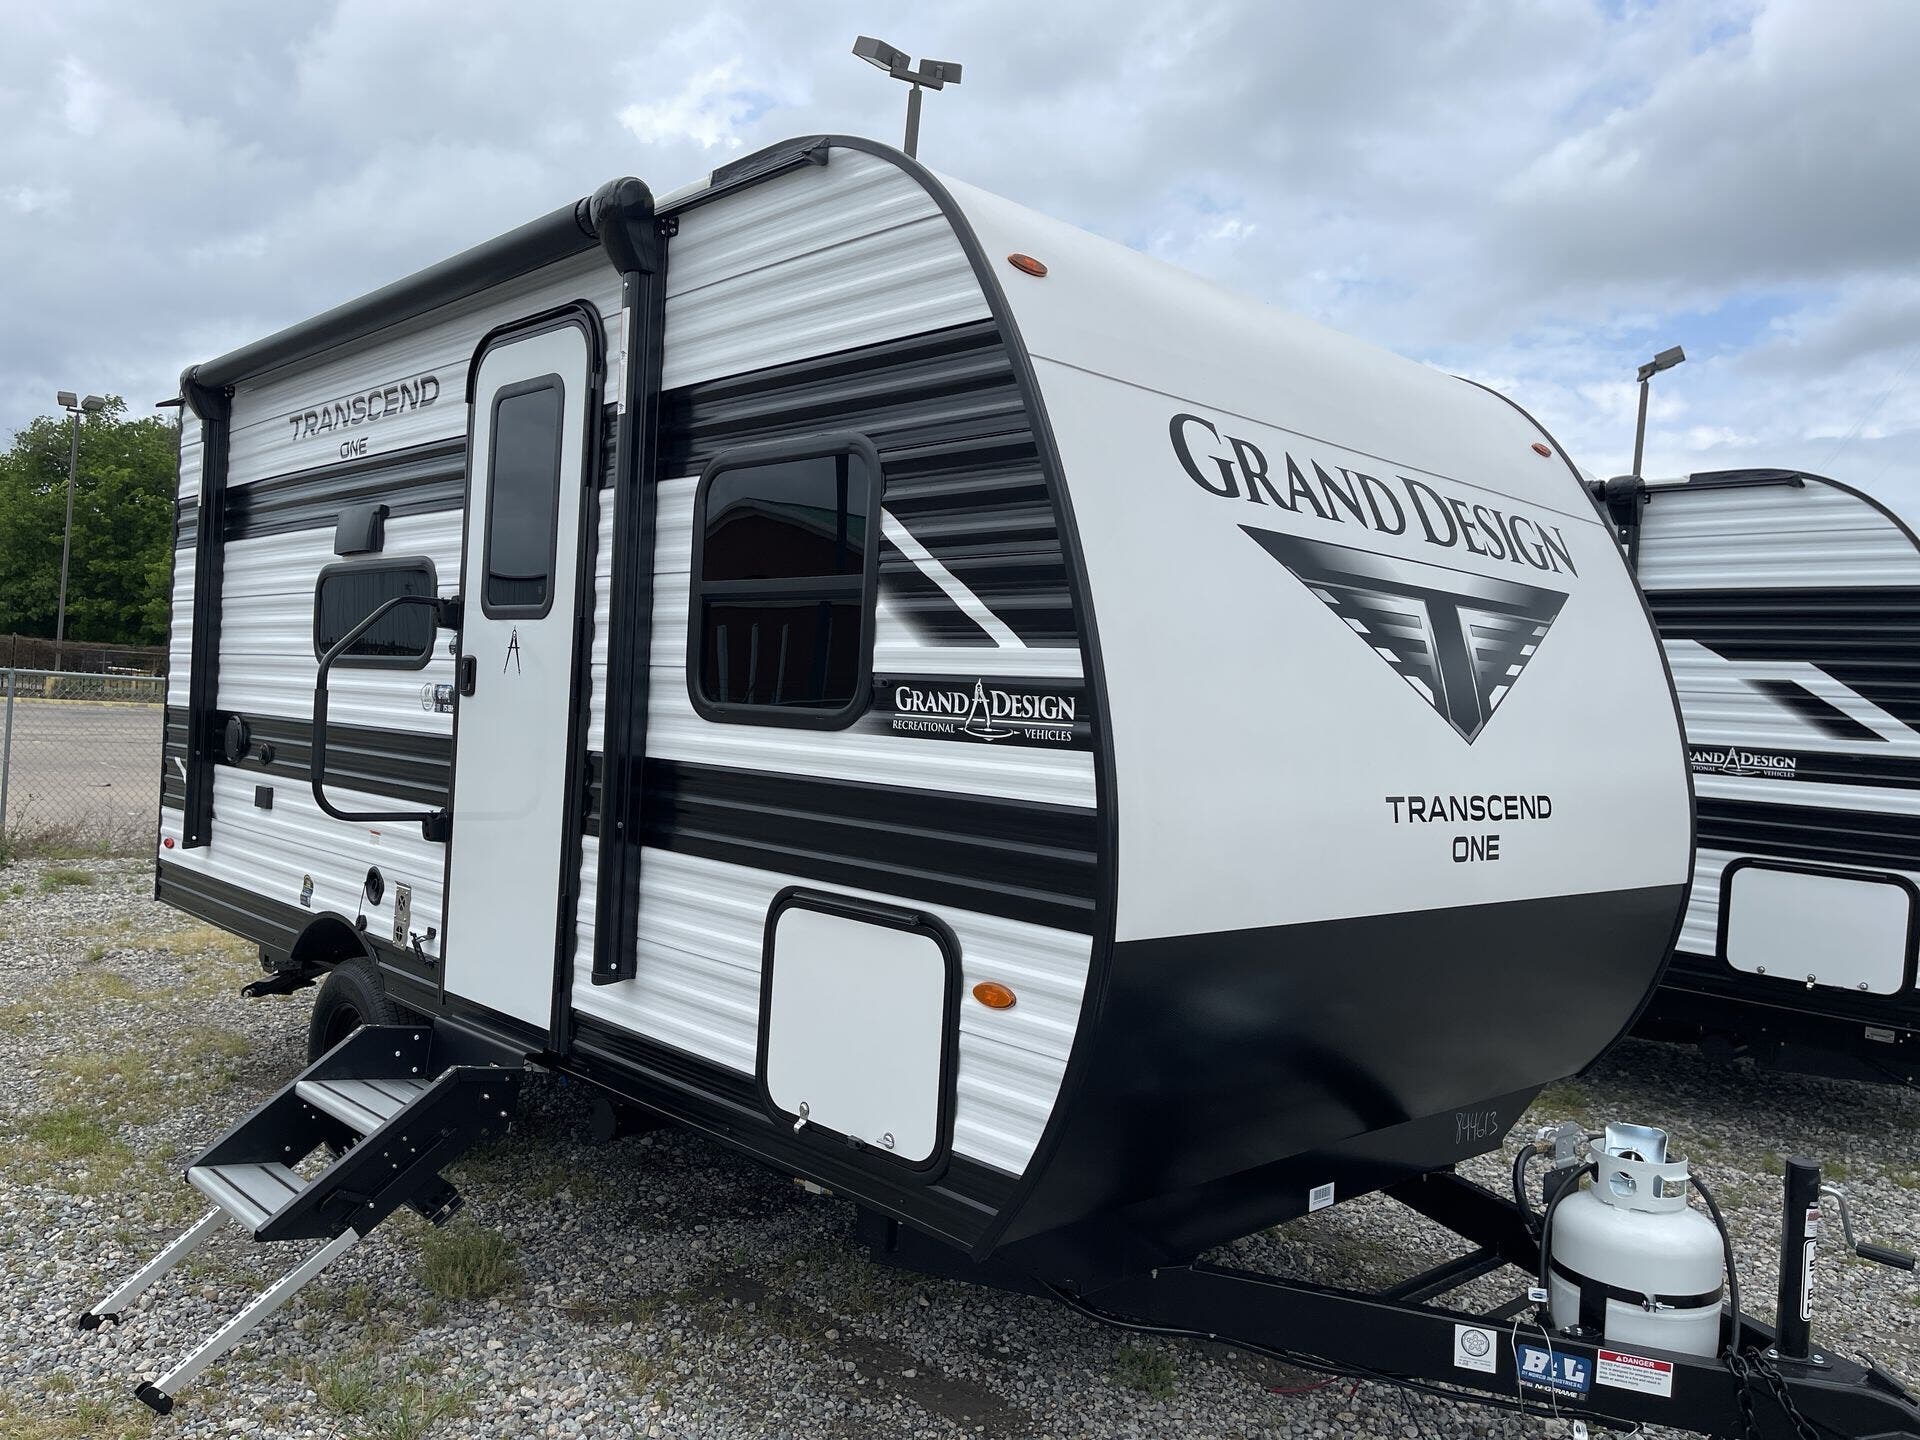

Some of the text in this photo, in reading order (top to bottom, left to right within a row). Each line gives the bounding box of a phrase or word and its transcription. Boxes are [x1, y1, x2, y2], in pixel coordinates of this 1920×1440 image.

[289, 375, 440, 441] TRANSCEND
[339, 437, 369, 459] ONE
[1168, 413, 1579, 579] GRAND DESIGN
[895, 686, 1076, 721] GRAND DESIGN
[892, 719, 1072, 742] RECREATIONAL VEHICLES
[1739, 752, 1796, 769] DESIGN
[1763, 769, 1795, 778] VEHICLES
[1385, 794, 1553, 824] TRANSCEND
[1451, 834, 1500, 863] ONE
[1455, 1111, 1498, 1145] 844613
[1622, 1356, 1655, 1369] DANGER
